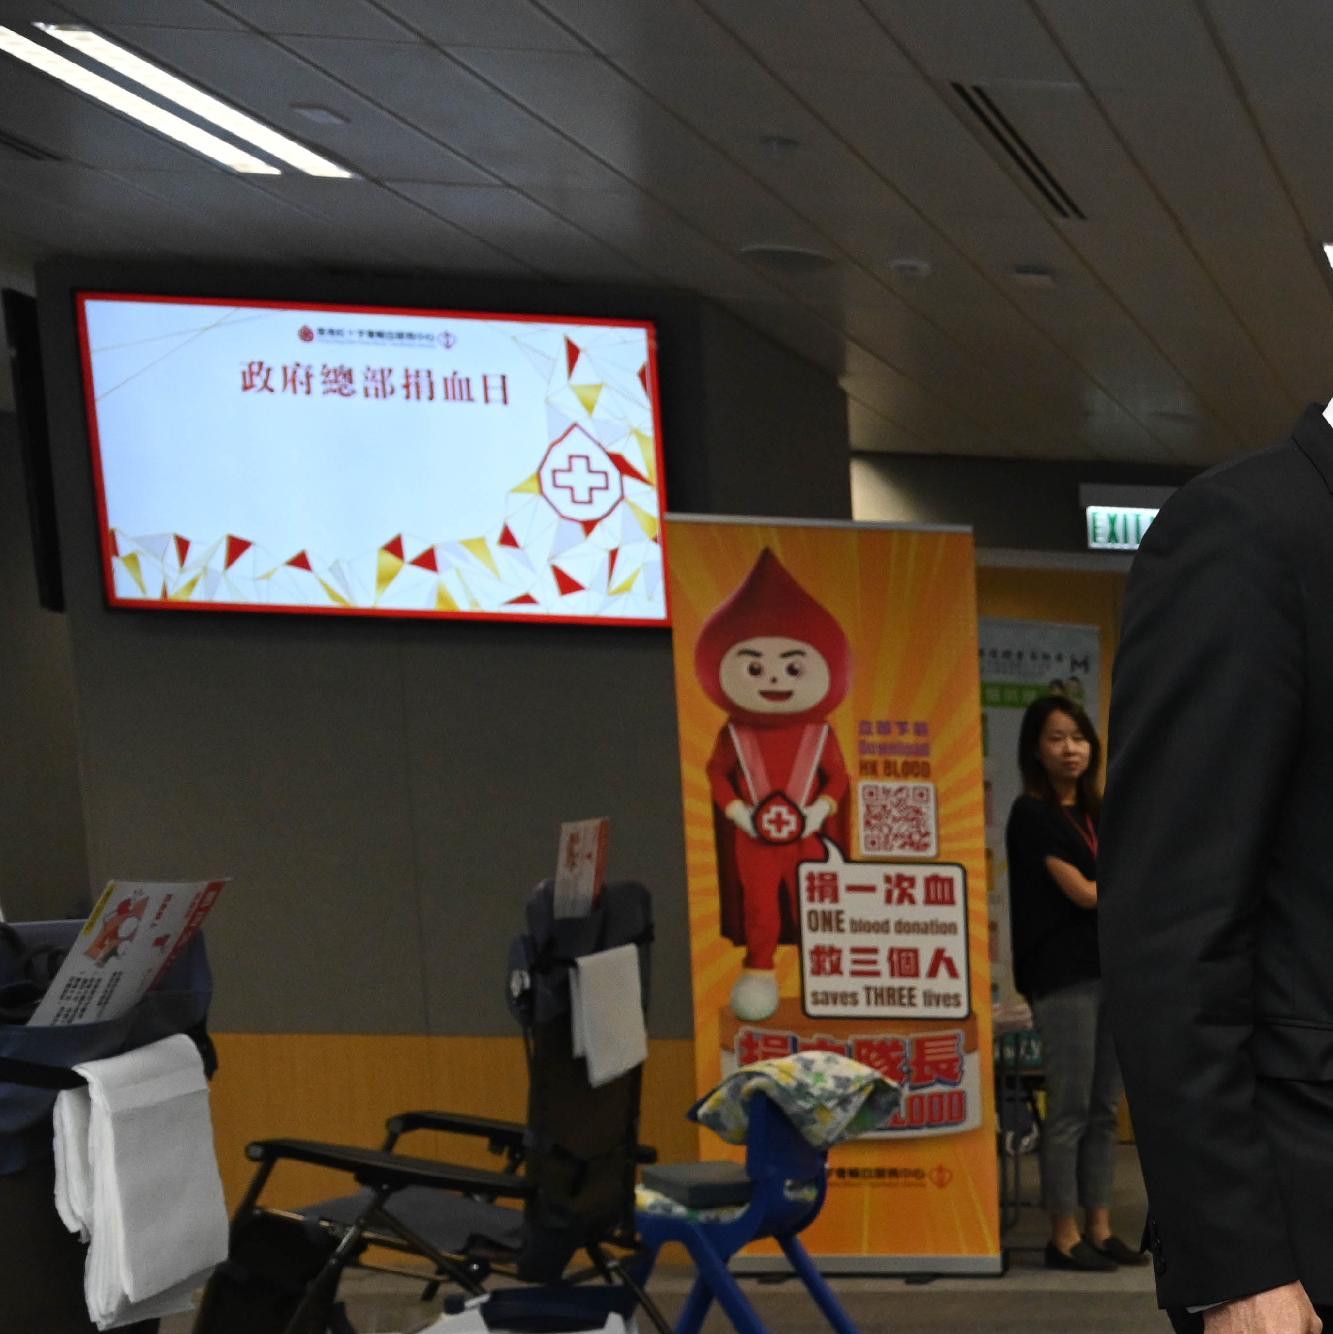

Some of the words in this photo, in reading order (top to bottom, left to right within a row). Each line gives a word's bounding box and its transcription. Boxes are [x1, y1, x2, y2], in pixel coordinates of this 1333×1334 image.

[241, 360, 508, 405] 政府總部捐血日
[1092, 511, 1143, 545] EXIT
[884, 760, 931, 778] BLOOD
[805, 871, 957, 907] 捐一次血
[807, 909, 845, 933] ONE
[850, 916, 890, 934] blood
[895, 917, 958, 935] donation
[810, 943, 960, 980] 救三個人
[811, 989, 860, 1008] saves
[863, 985, 918, 1008] THREE
[922, 989, 962, 1008] lives
